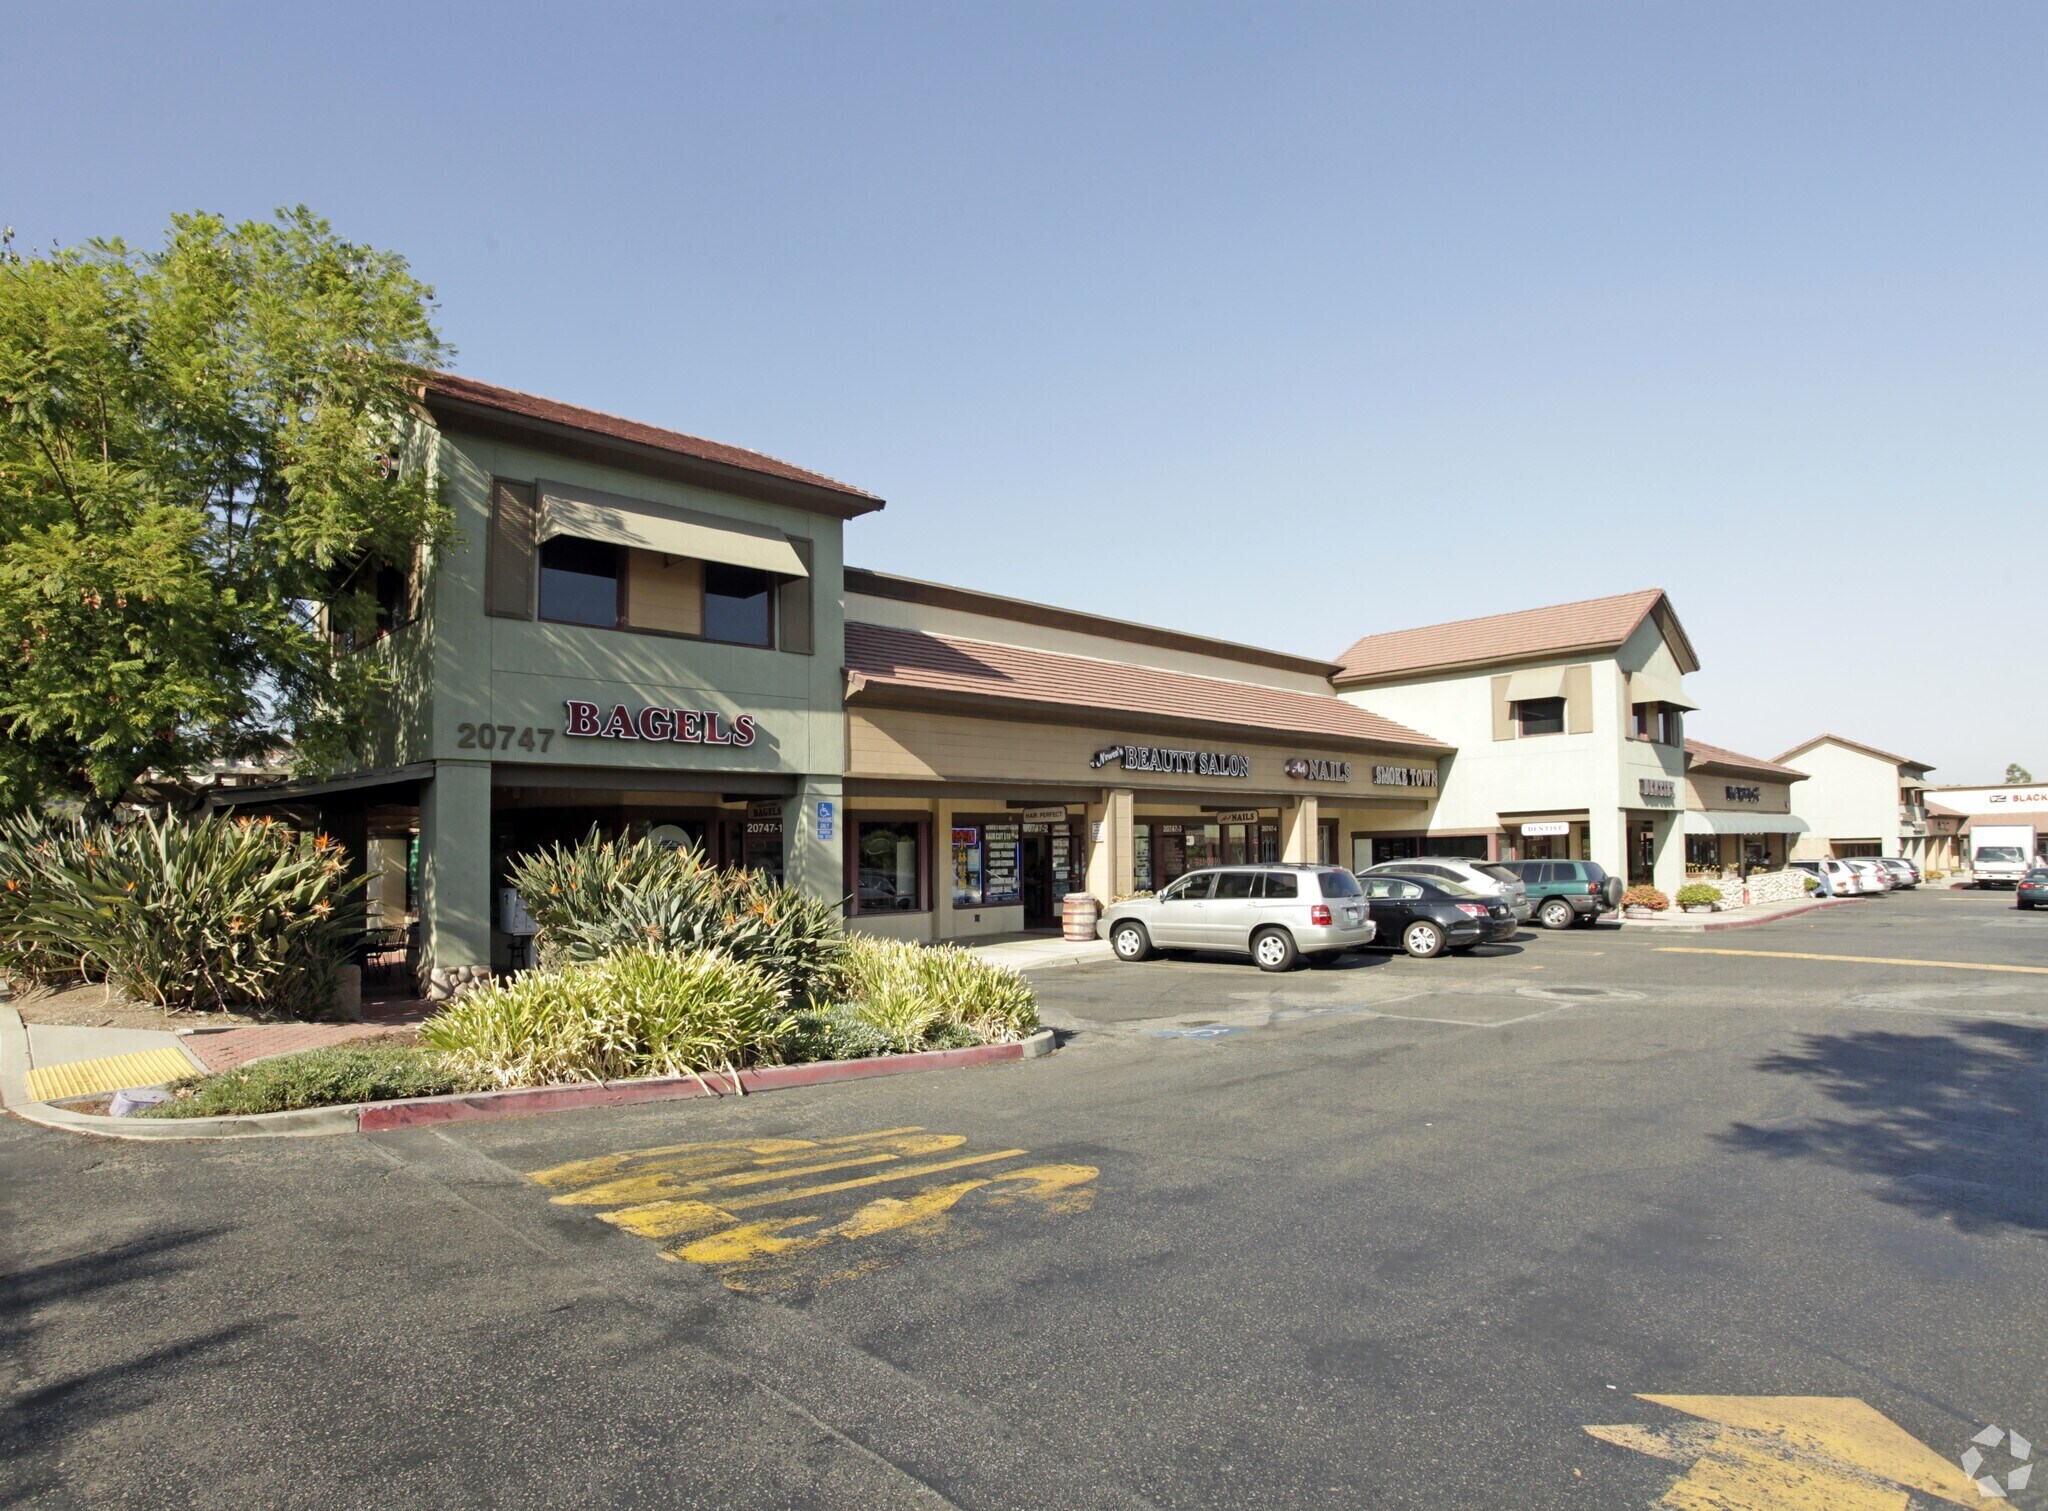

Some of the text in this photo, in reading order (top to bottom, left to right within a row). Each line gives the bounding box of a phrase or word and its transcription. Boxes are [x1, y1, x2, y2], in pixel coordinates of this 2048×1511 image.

[566, 700, 756, 747] BAGELS
[457, 722, 555, 753] 20747
[1124, 746, 1196, 773] BEAUTY
[1199, 753, 1249, 777] SALON
[1291, 759, 1352, 782] Art NAILS
[1375, 765, 1438, 787] SMOKE TOWN
[753, 806, 782, 817] BAGELS
[1231, 812, 1255, 822] NAILS
[747, 823, 783, 833] 20747-1
[524, 1125, 1102, 1294] STOP
